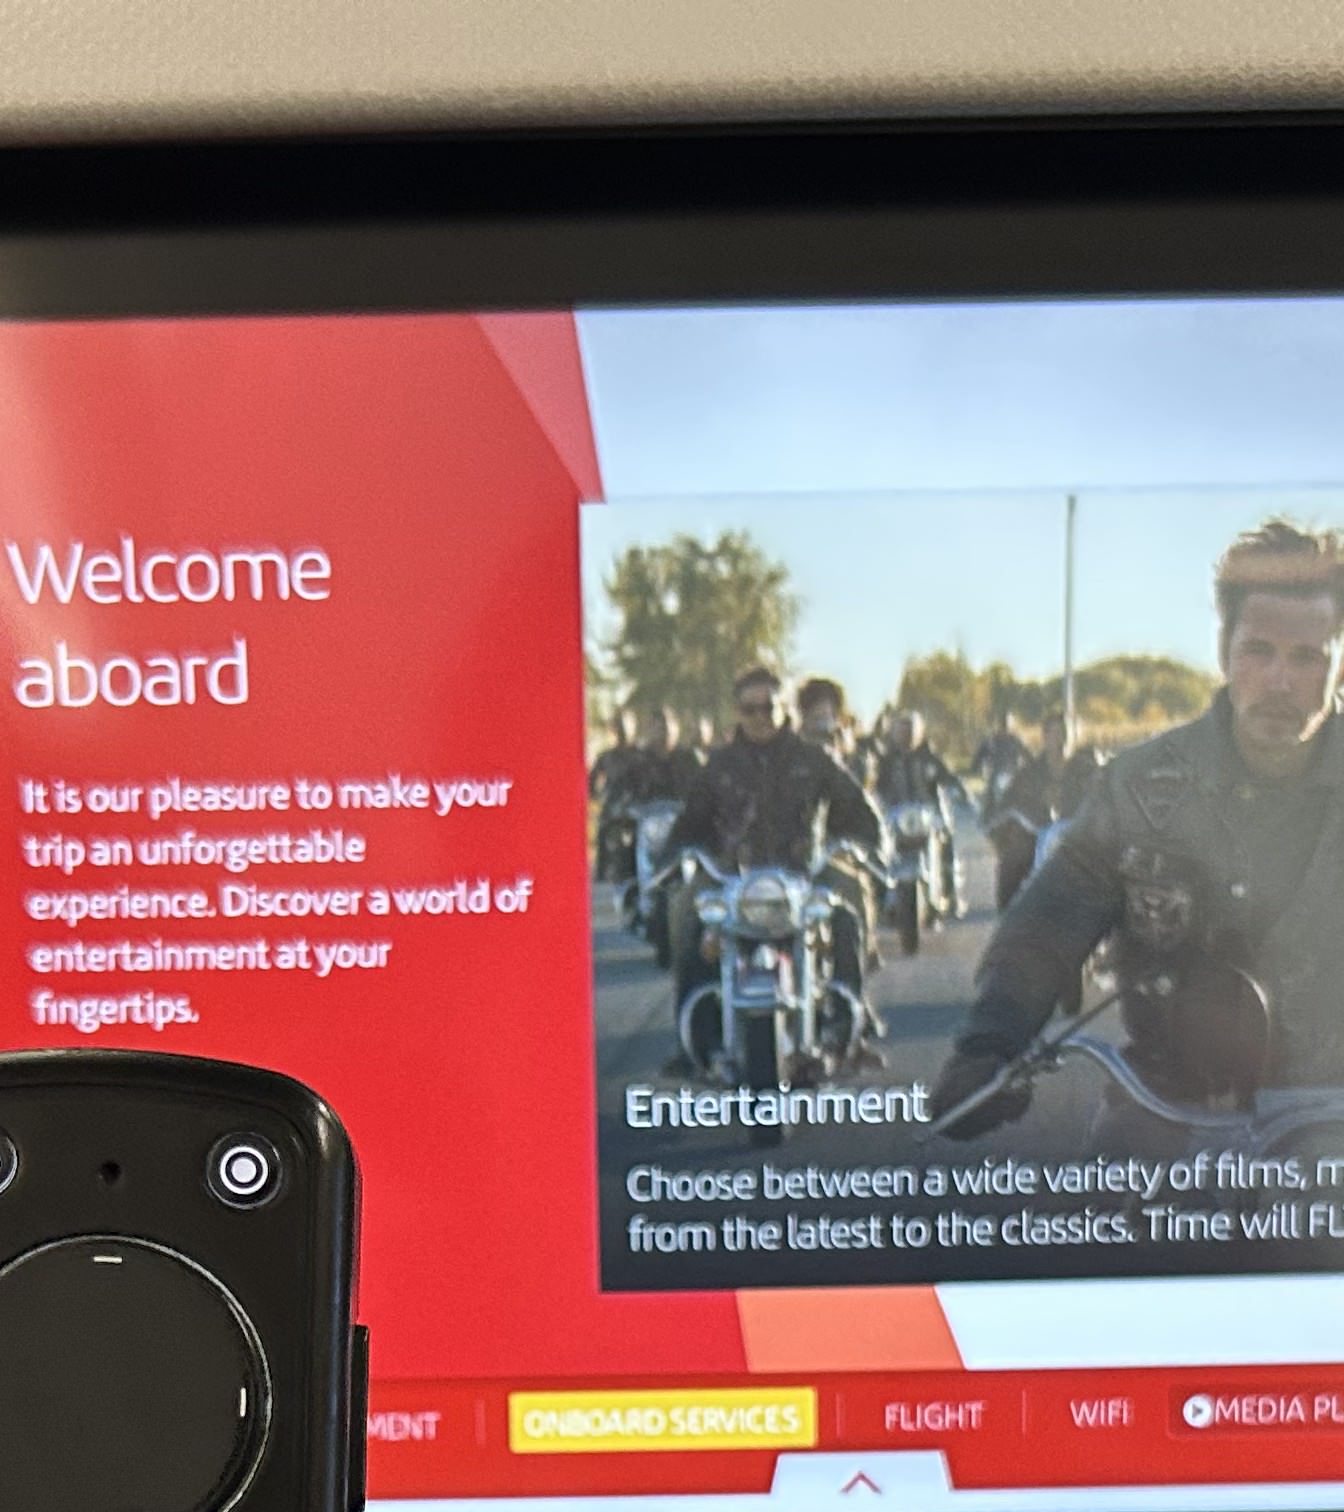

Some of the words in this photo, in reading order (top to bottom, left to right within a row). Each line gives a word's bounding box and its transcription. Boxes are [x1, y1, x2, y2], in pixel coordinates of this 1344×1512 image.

[6, 533, 331, 604] Welcome
[14, 634, 249, 707] aboard
[21, 778, 50, 813] It
[54, 779, 82, 813] is
[86, 780, 142, 813] our
[149, 775, 290, 820] pleasure
[296, 777, 333, 810] to
[339, 772, 430, 809] make
[434, 778, 512, 817] your
[24, 834, 85, 875] trip
[88, 838, 133, 866] an
[138, 828, 366, 873] unforgettable
[27, 885, 216, 928] experience.
[220, 882, 362, 917] Discover
[367, 888, 390, 915] a
[392, 877, 490, 914] world
[495, 874, 533, 913] of
[30, 938, 271, 972] entertainment
[274, 937, 311, 970] at
[313, 940, 392, 978] your
[31, 987, 200, 1034] fingertips.
[625, 1080, 932, 1129] Entertainment
[626, 1163, 756, 1202] Choose
[762, 1159, 919, 1200] between
[923, 1165, 948, 1197] a
[952, 1155, 1037, 1196] wide
[1043, 1154, 1161, 1200] variety
[1169, 1149, 1209, 1192] of
[1216, 1149, 1306, 1192] films,
[628, 1212, 717, 1252] from
[721, 1212, 783, 1251] the
[786, 1211, 885, 1251] latest
[892, 1215, 932, 1249] to
[936, 1209, 995, 1247] the
[1001, 1205, 1138, 1246] classics.
[1142, 1203, 1232, 1243] Time
[1240, 1202, 1301, 1240] will
[522, 1406, 666, 1439] ONBOARD
[669, 1403, 800, 1437] SERVICES
[883, 1400, 985, 1432] FLIGHT
[1069, 1396, 1131, 1429] WIFI
[1213, 1394, 1306, 1425] MEDIA
